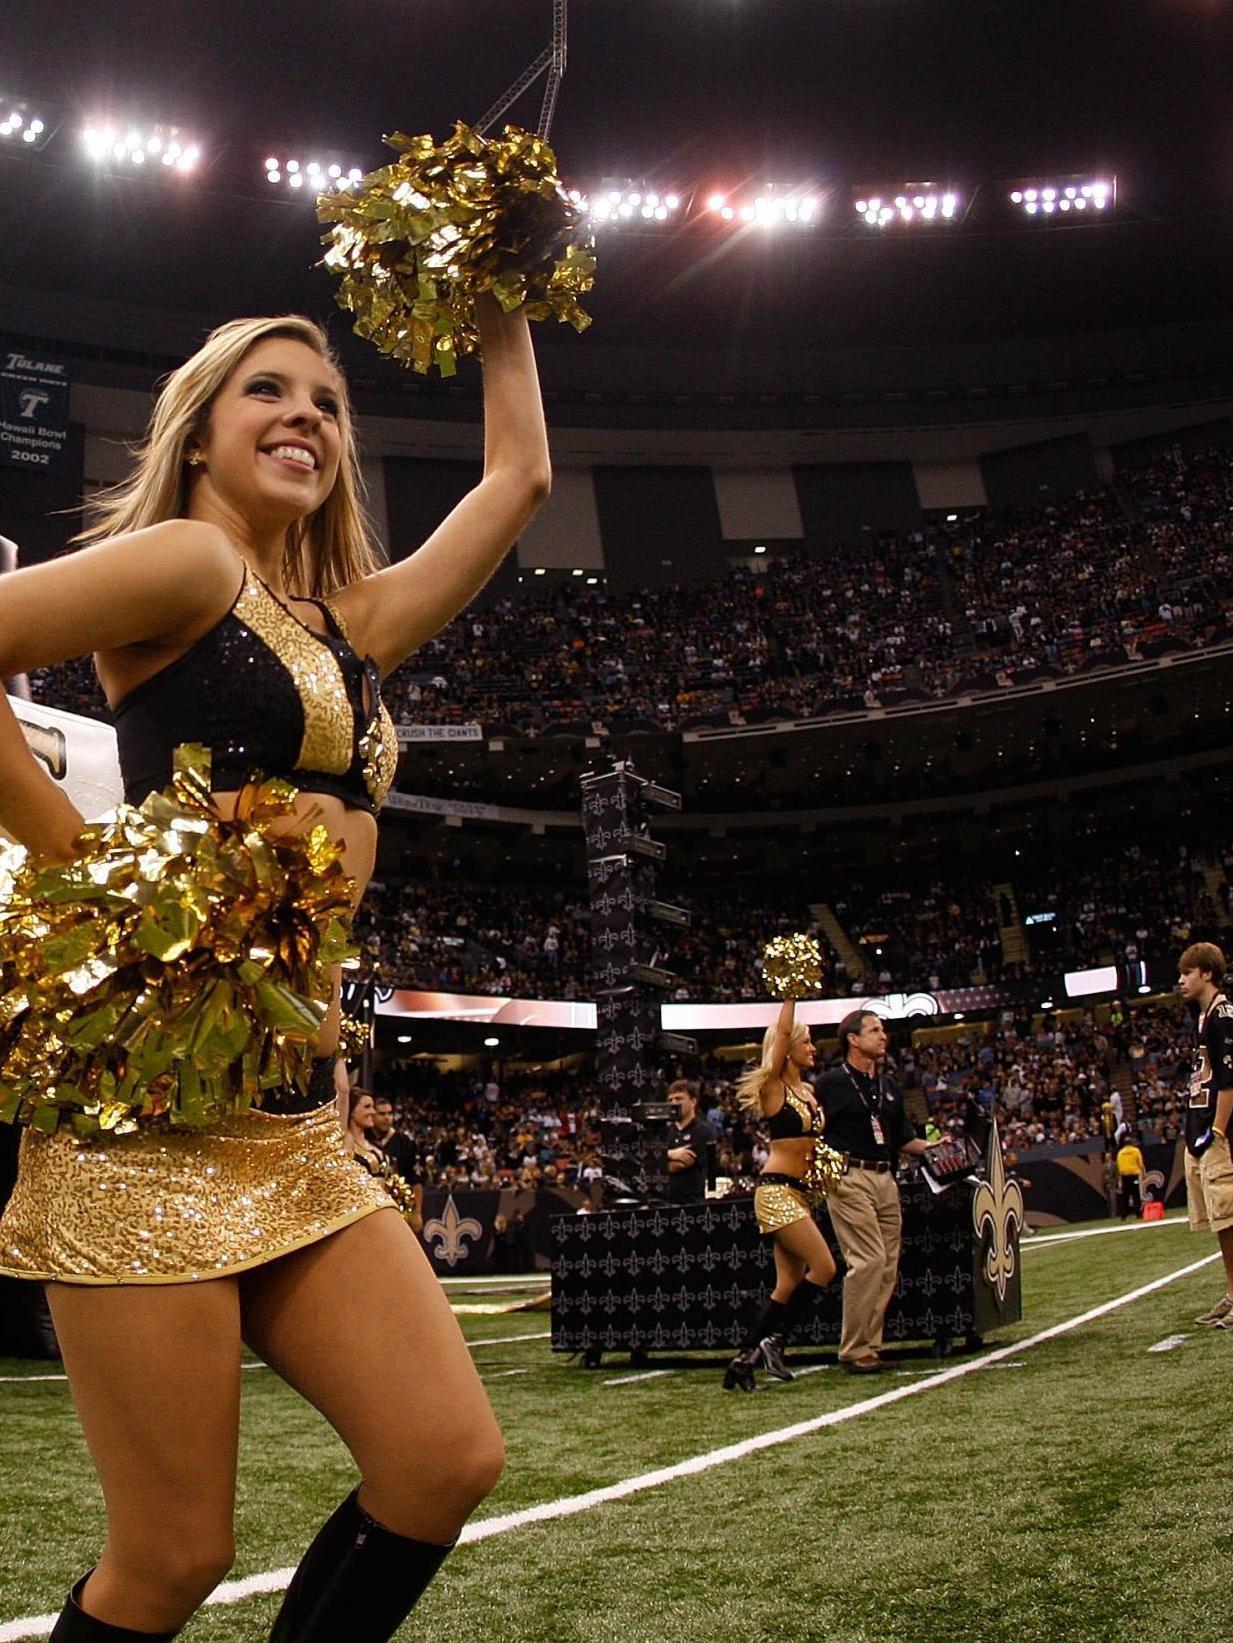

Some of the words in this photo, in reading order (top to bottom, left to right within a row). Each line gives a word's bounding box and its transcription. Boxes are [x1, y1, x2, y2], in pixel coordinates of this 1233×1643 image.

[6, 353, 65, 375] TULANE
[0, 431, 62, 450] Champions
[38, 427, 67, 440] Bowl
[11, 450, 50, 465] 2002
[397, 727, 425, 738] CRUSH
[427, 727, 446, 738] THE
[448, 727, 480, 738] GIANTS
